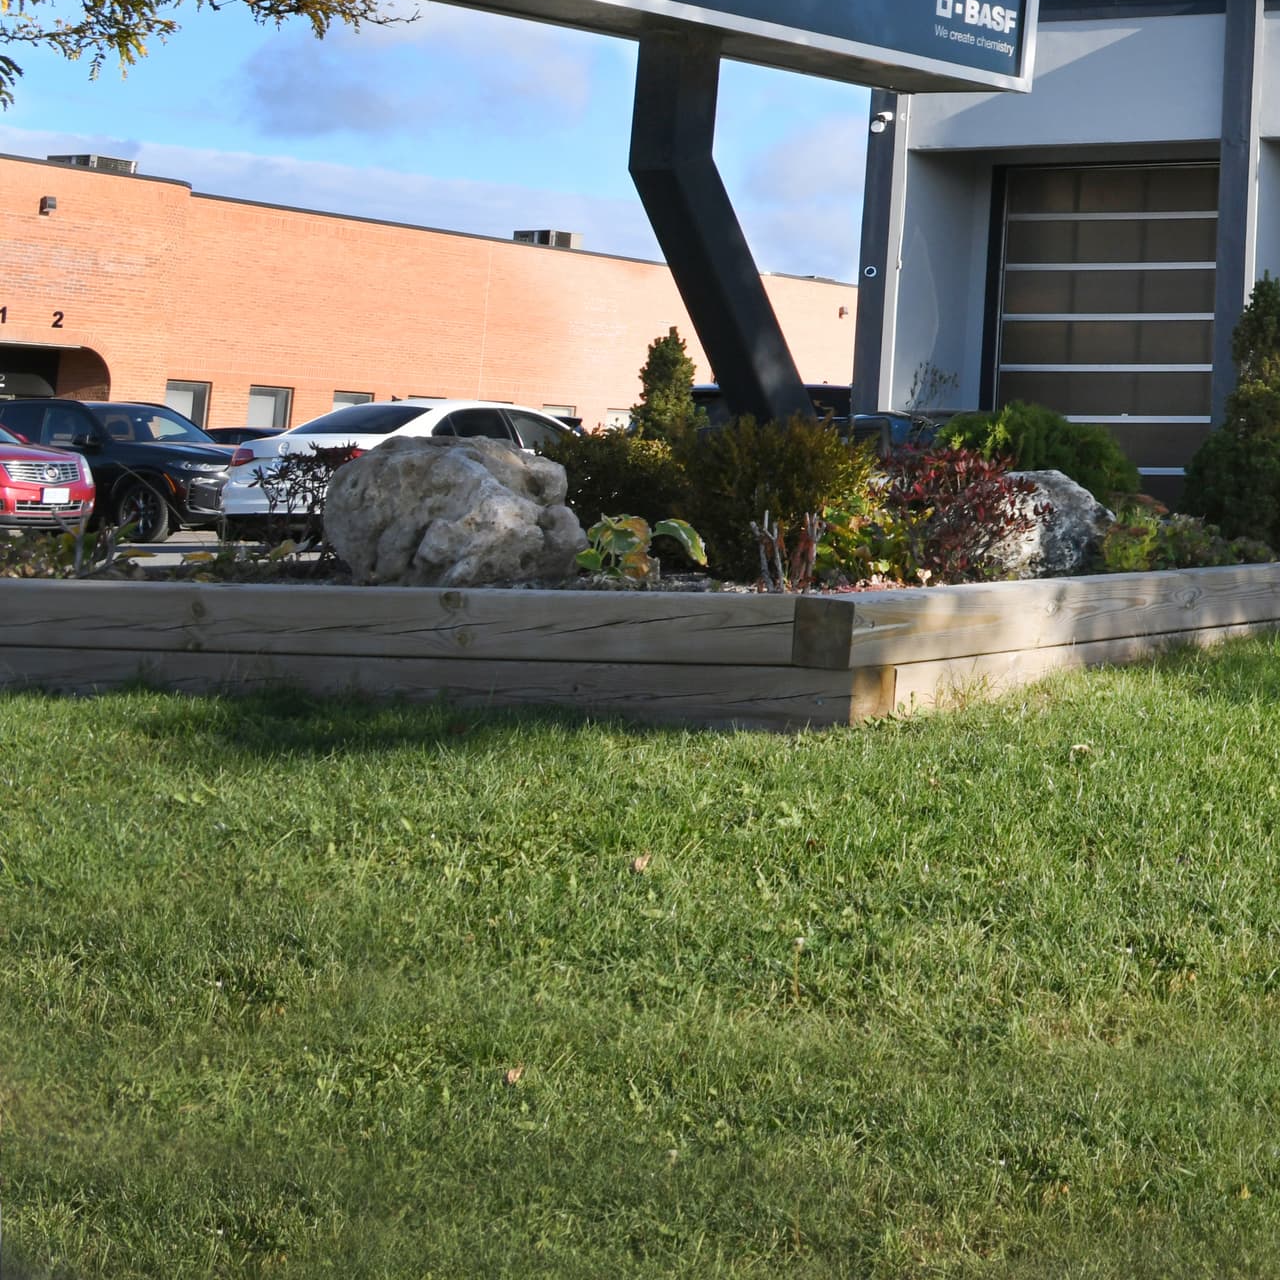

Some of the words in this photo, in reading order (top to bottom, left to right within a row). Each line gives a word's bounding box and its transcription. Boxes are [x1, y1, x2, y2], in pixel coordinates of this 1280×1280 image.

[934, 23, 949, 38] We
[949, 29, 976, 45] create
[976, 35, 1015, 57] chemistry
[51, 311, 65, 328] 2
